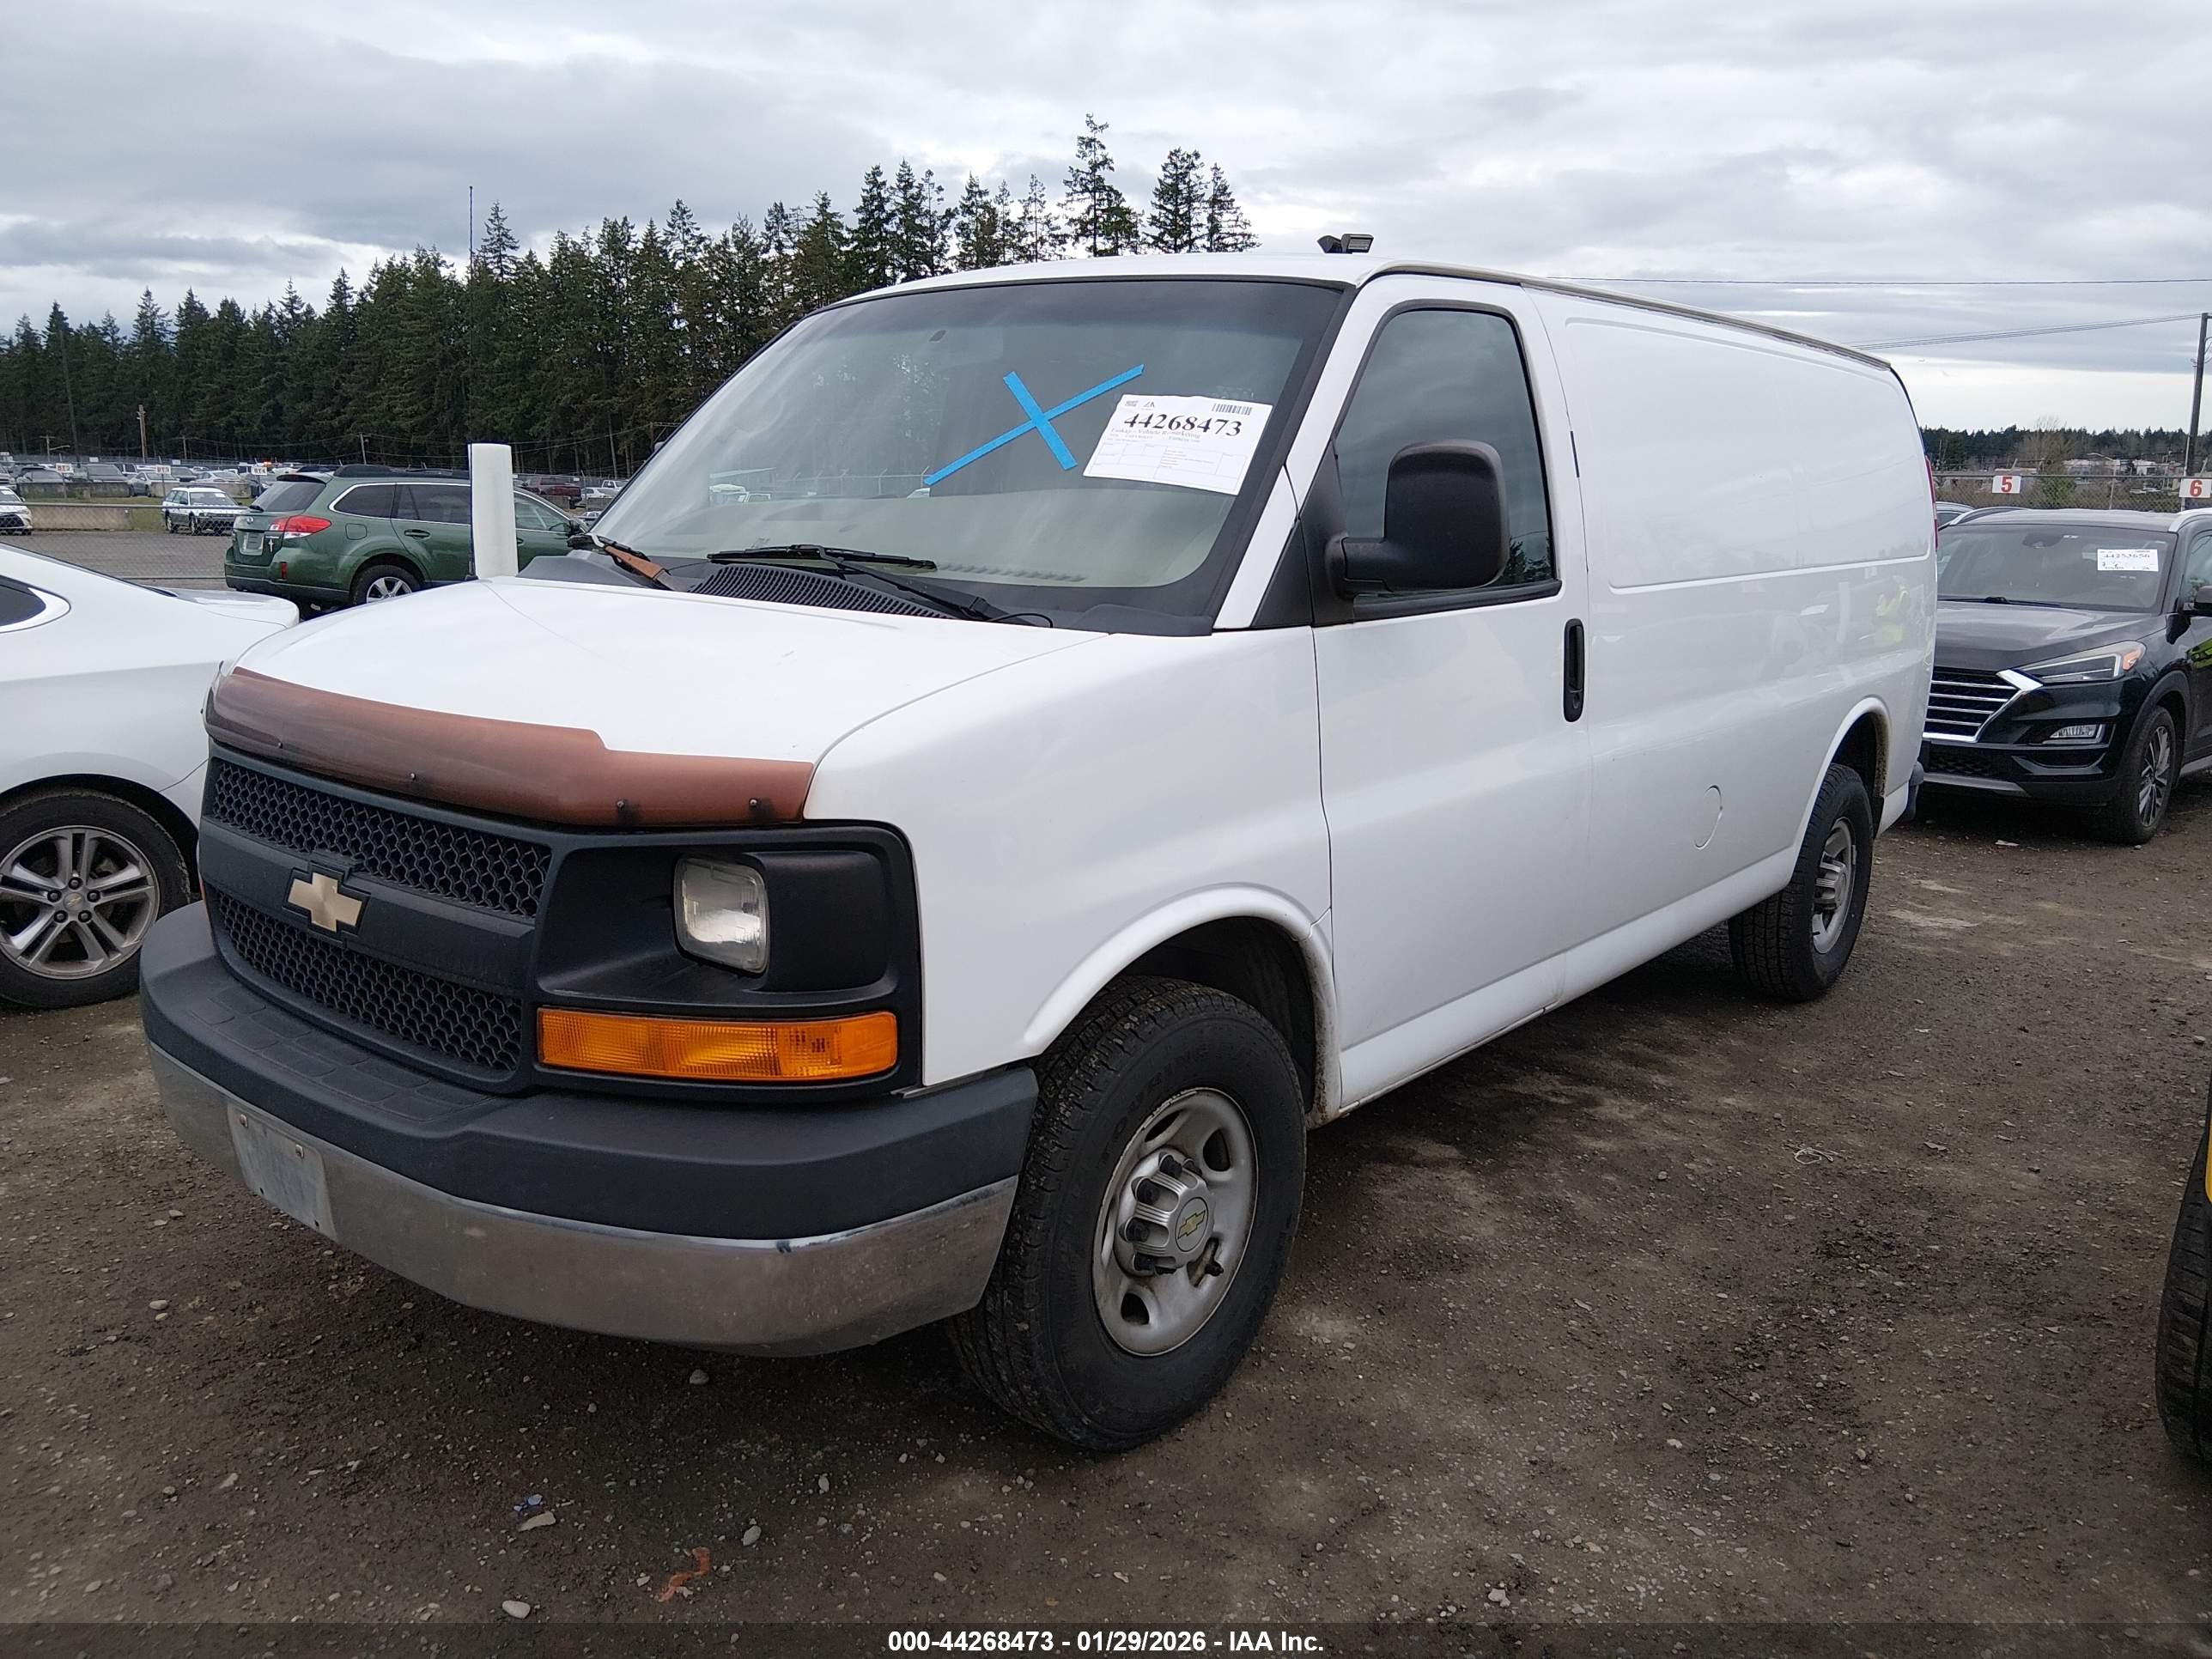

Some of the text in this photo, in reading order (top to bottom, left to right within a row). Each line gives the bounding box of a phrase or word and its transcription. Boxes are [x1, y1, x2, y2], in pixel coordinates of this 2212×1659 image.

[1123, 413, 1243, 437] 44268473
[2001, 476, 2013, 492] 5
[2190, 479, 2203, 496] 6
